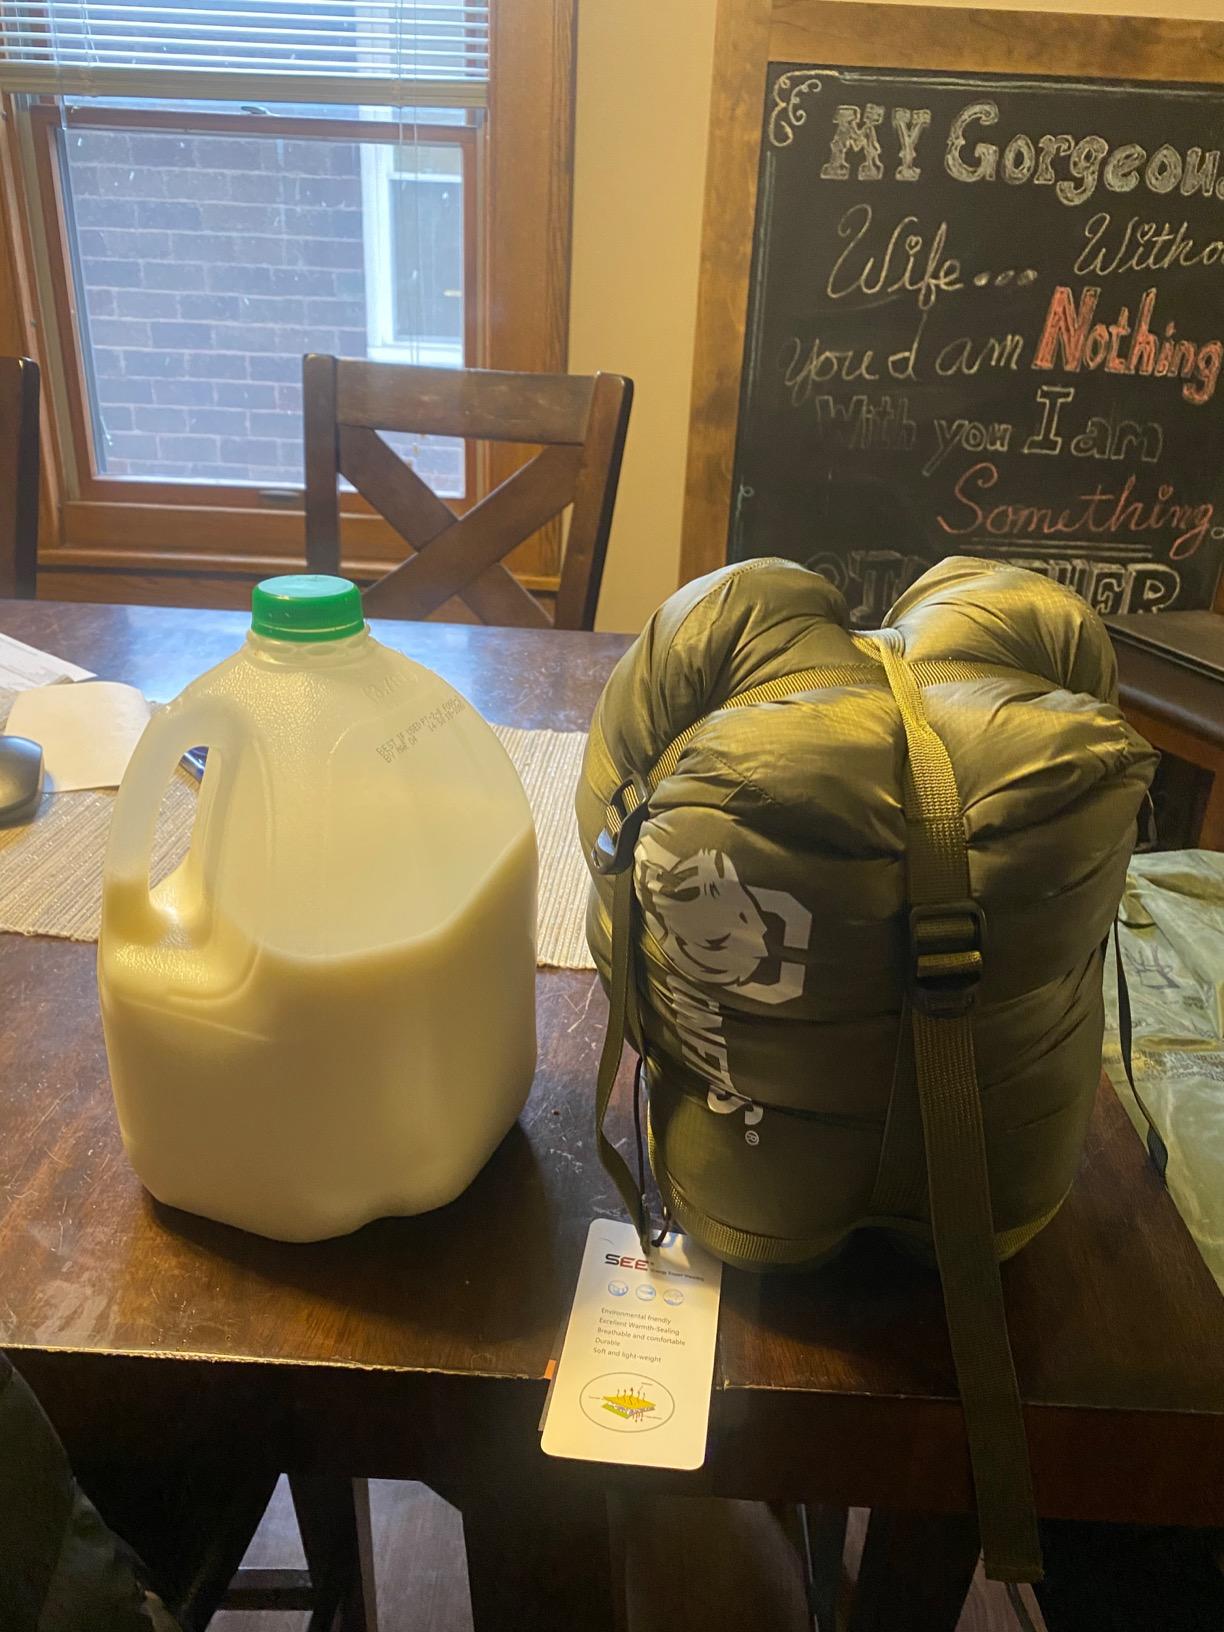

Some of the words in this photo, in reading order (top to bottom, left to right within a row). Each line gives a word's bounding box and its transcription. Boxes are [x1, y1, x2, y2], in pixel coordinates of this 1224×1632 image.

[819, 103, 933, 182] MY
[935, 334, 1023, 375] am
[1030, 286, 1223, 406] Nothing
[922, 419, 1012, 477] you
[1023, 384, 1074, 454] I
[1070, 415, 1164, 463] am
[605, 1253, 649, 1271] SEE
[601, 1307, 647, 1320] Environmental
[647, 1314, 671, 1325] friendly
[599, 1317, 627, 1328] Excellent
[628, 1321, 680, 1336] Warmth-Sealing
[595, 1337, 621, 1346] Durable
[597, 1327, 631, 1338] Breathable
[632, 1333, 645, 1341] and
[646, 1336, 686, 1346] comfortable
[593, 1346, 606, 1356] Soft
[607, 1349, 621, 1357] and
[621, 1351, 661, 1363] light-weight
